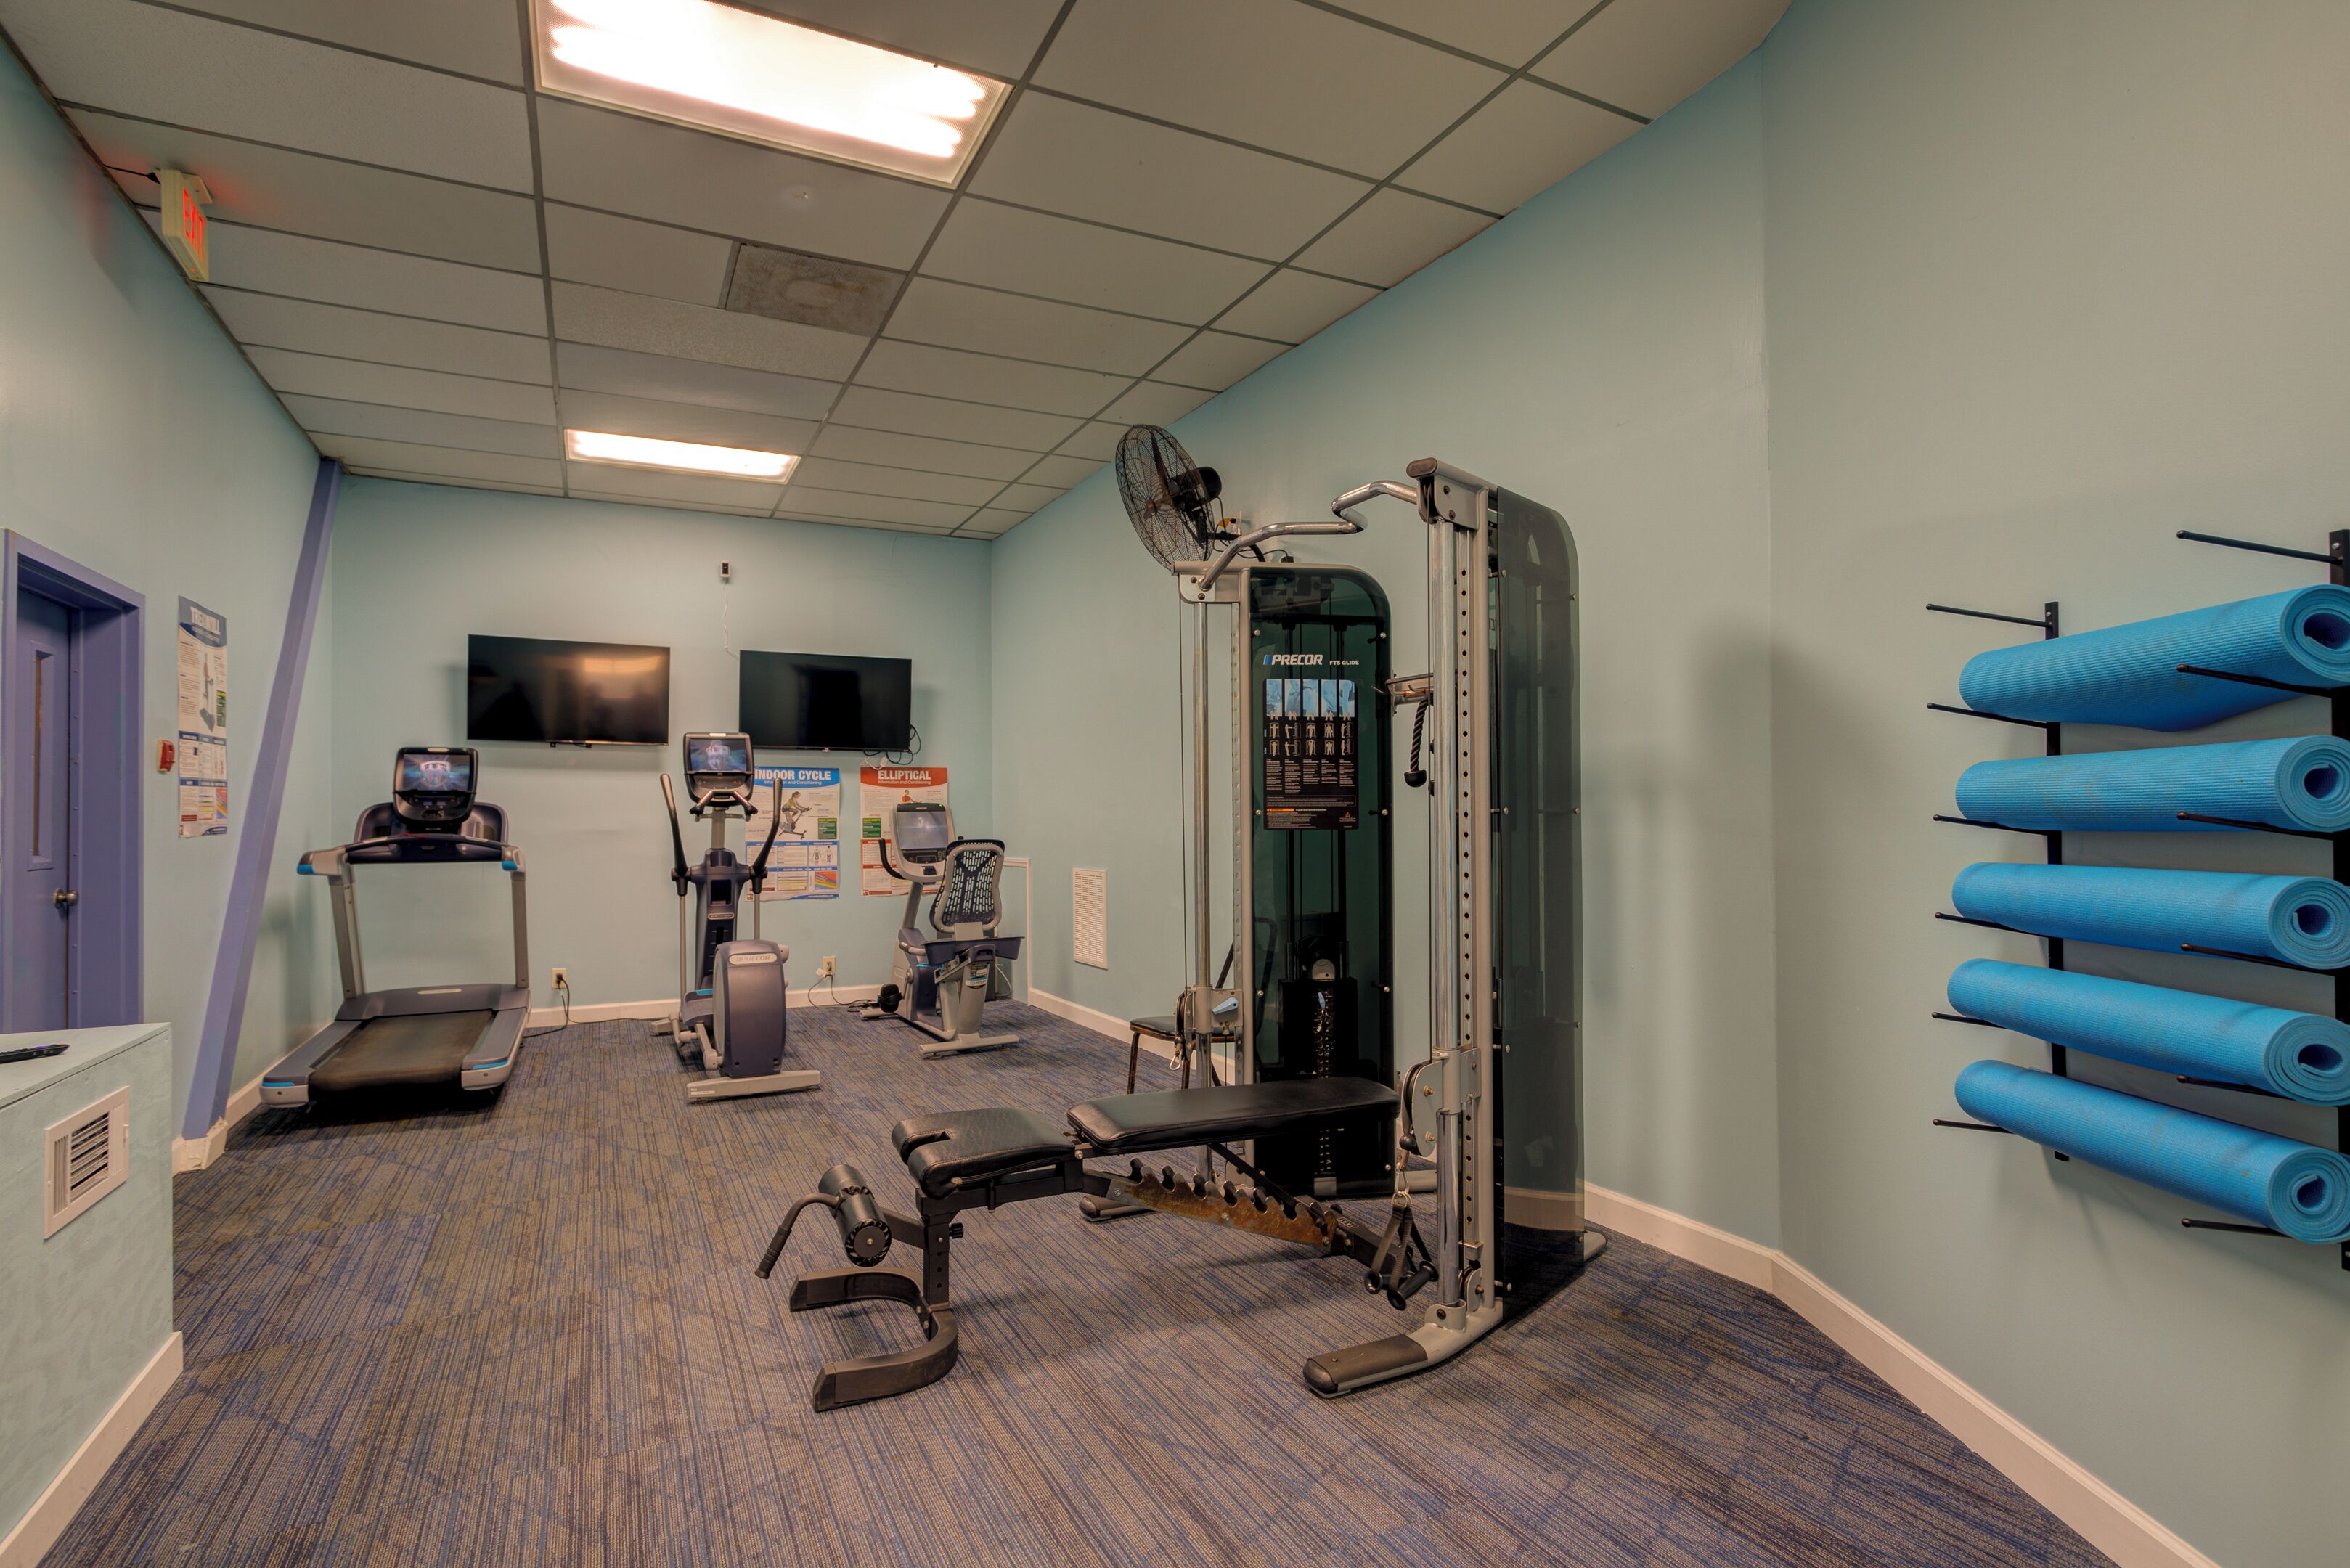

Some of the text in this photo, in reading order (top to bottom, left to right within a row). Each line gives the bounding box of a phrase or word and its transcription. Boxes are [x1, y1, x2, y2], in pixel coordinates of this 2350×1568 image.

[183, 188, 205, 265] EXIT
[1272, 654, 1323, 665] PRECOR
[755, 770, 831, 780] INDOOR CYCLE
[878, 770, 931, 780] ELLIPTICAL
